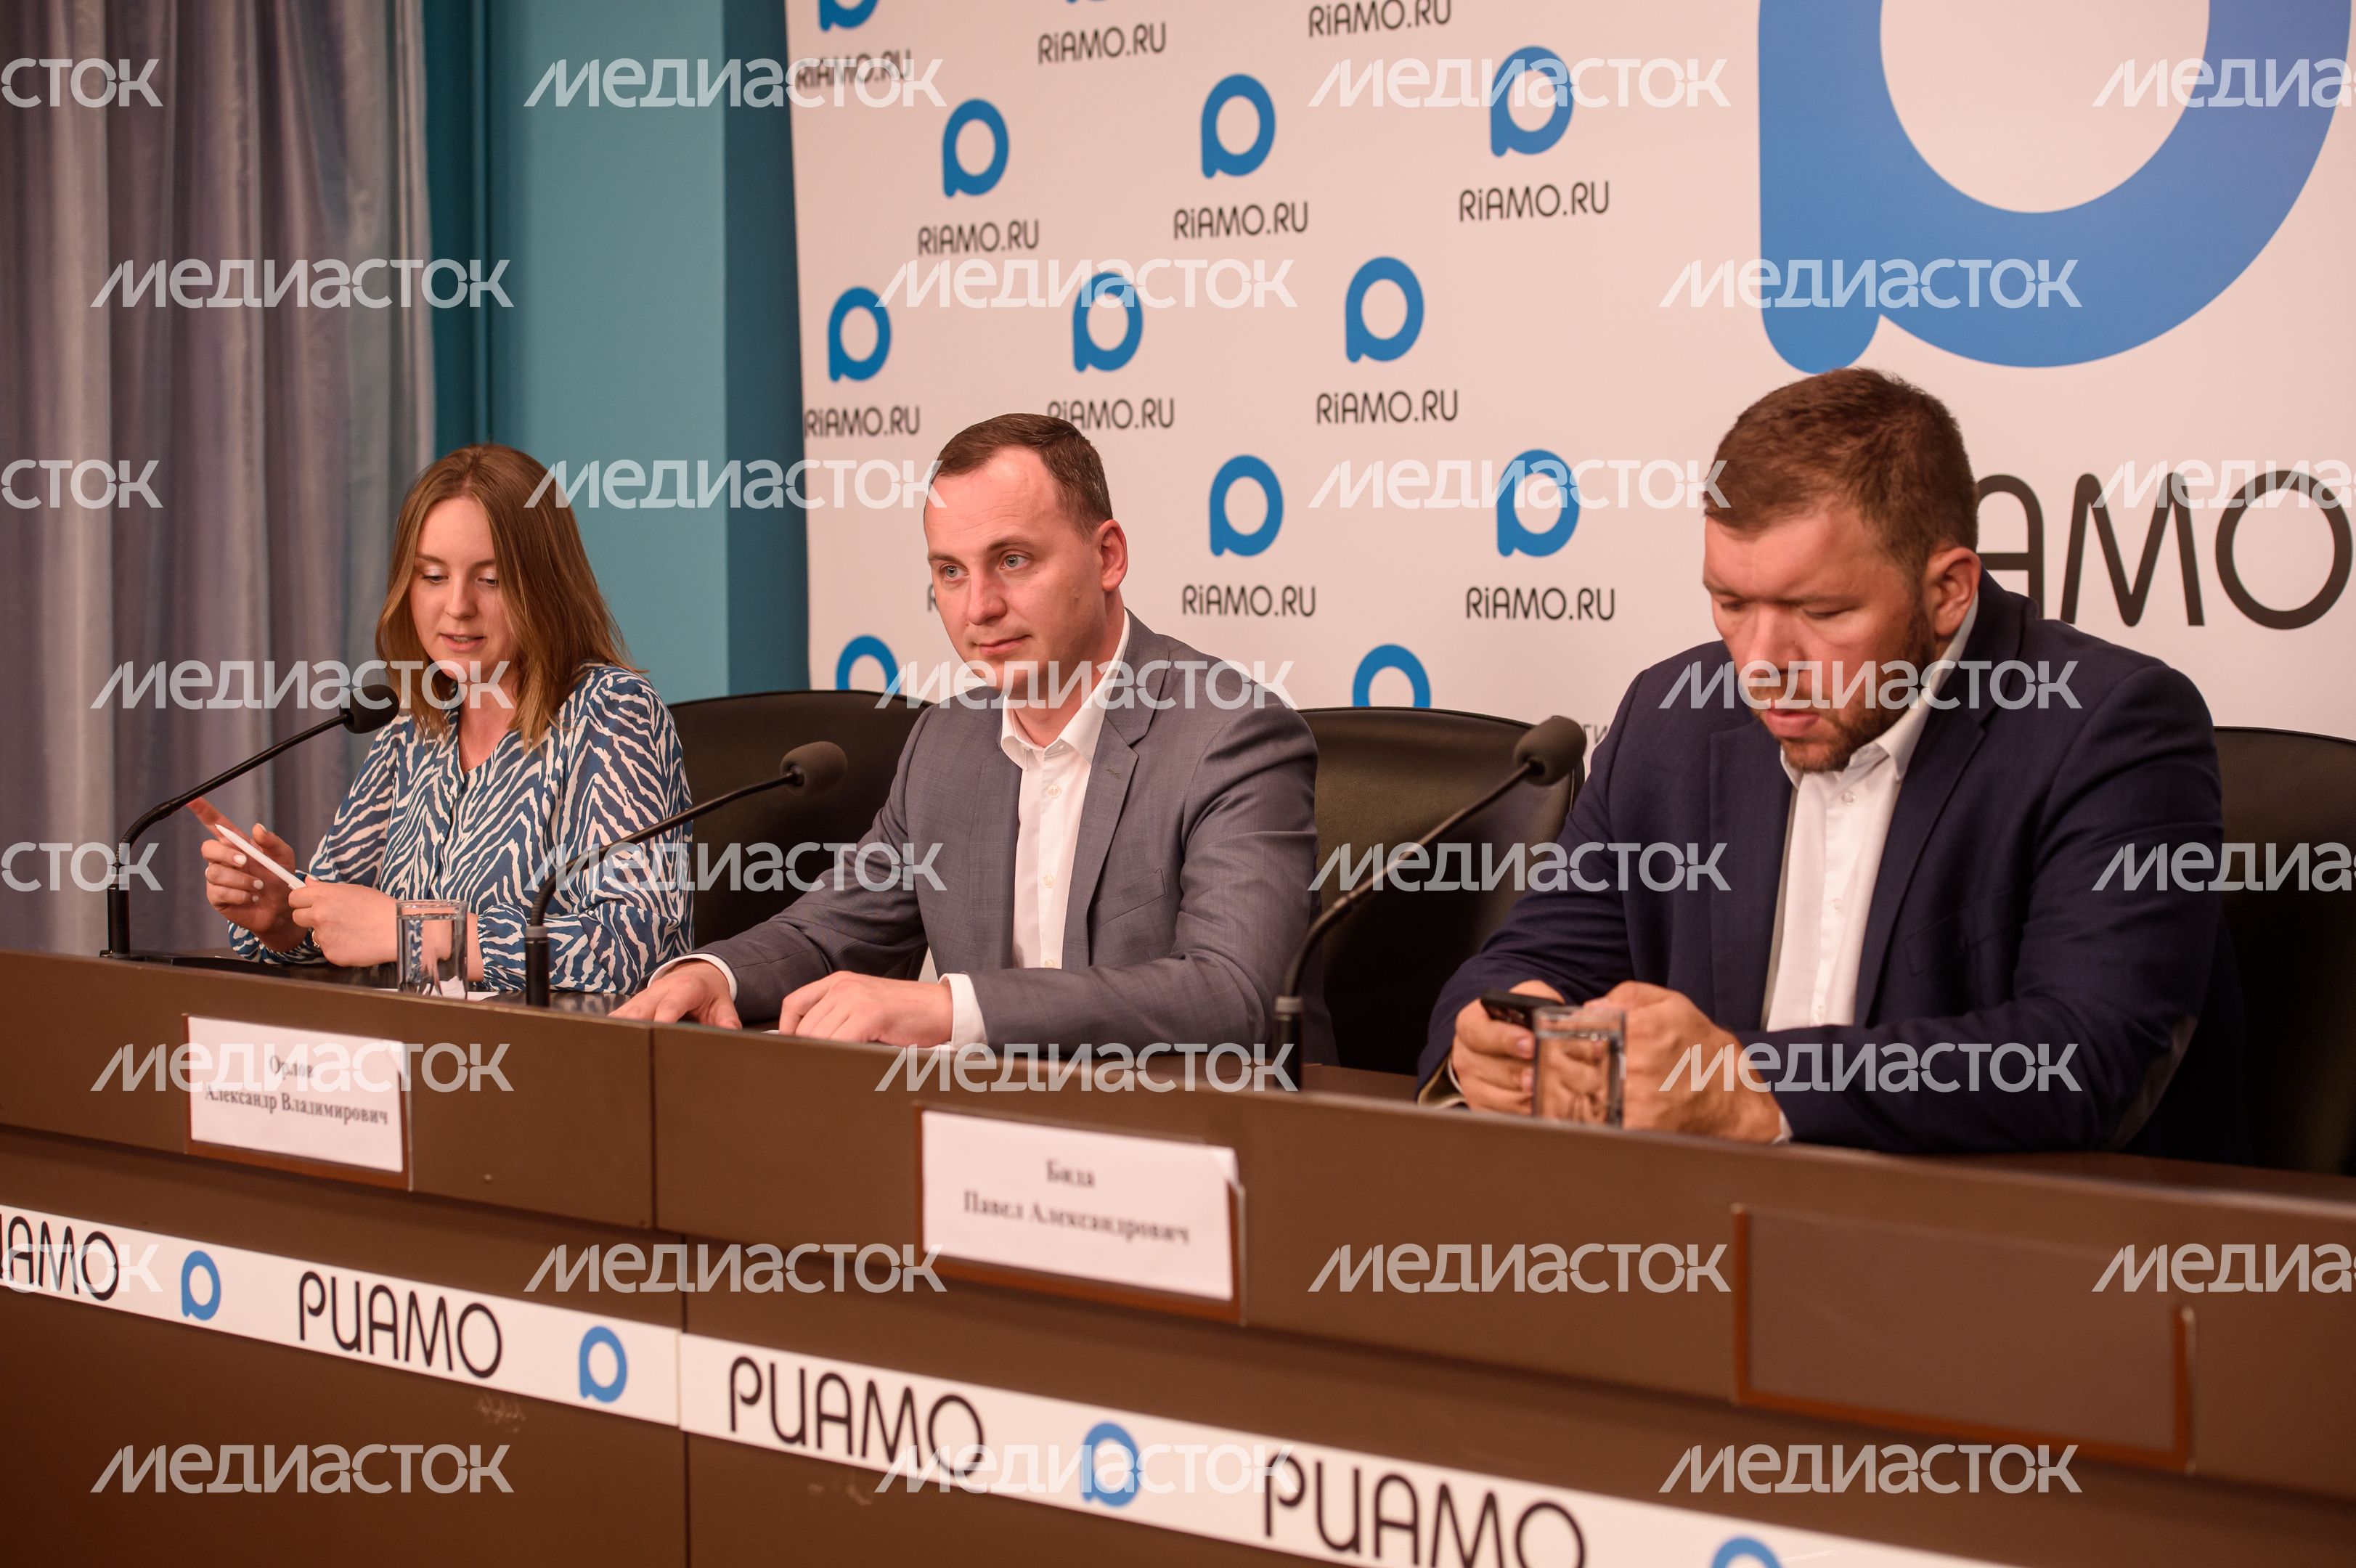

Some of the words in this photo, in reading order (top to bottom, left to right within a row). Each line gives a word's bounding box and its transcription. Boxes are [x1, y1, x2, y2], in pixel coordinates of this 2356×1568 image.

[1308, 0, 1452, 38] RiAMO.RU
[1038, 22, 1167, 65] RiAMO.RU
[1173, 201, 1309, 240] RiAMO.RU
[1459, 181, 1610, 222] RiAMO.RU
[917, 219, 1040, 257] RiAMO.RU
[804, 405, 921, 438] RiAMO.RU
[1316, 389, 1459, 425] RiAMO.RU
[1182, 584, 1316, 618] RiAMO.RU
[1466, 587, 1615, 621] RiAMO.RU
[205, 1085, 277, 1114] Александр
[281, 1092, 388, 1125] Владимирович
[963, 1191, 1024, 1220] Павел
[1031, 1202, 1191, 1243] Александрович
[0, 1214, 119, 1301] АМО
